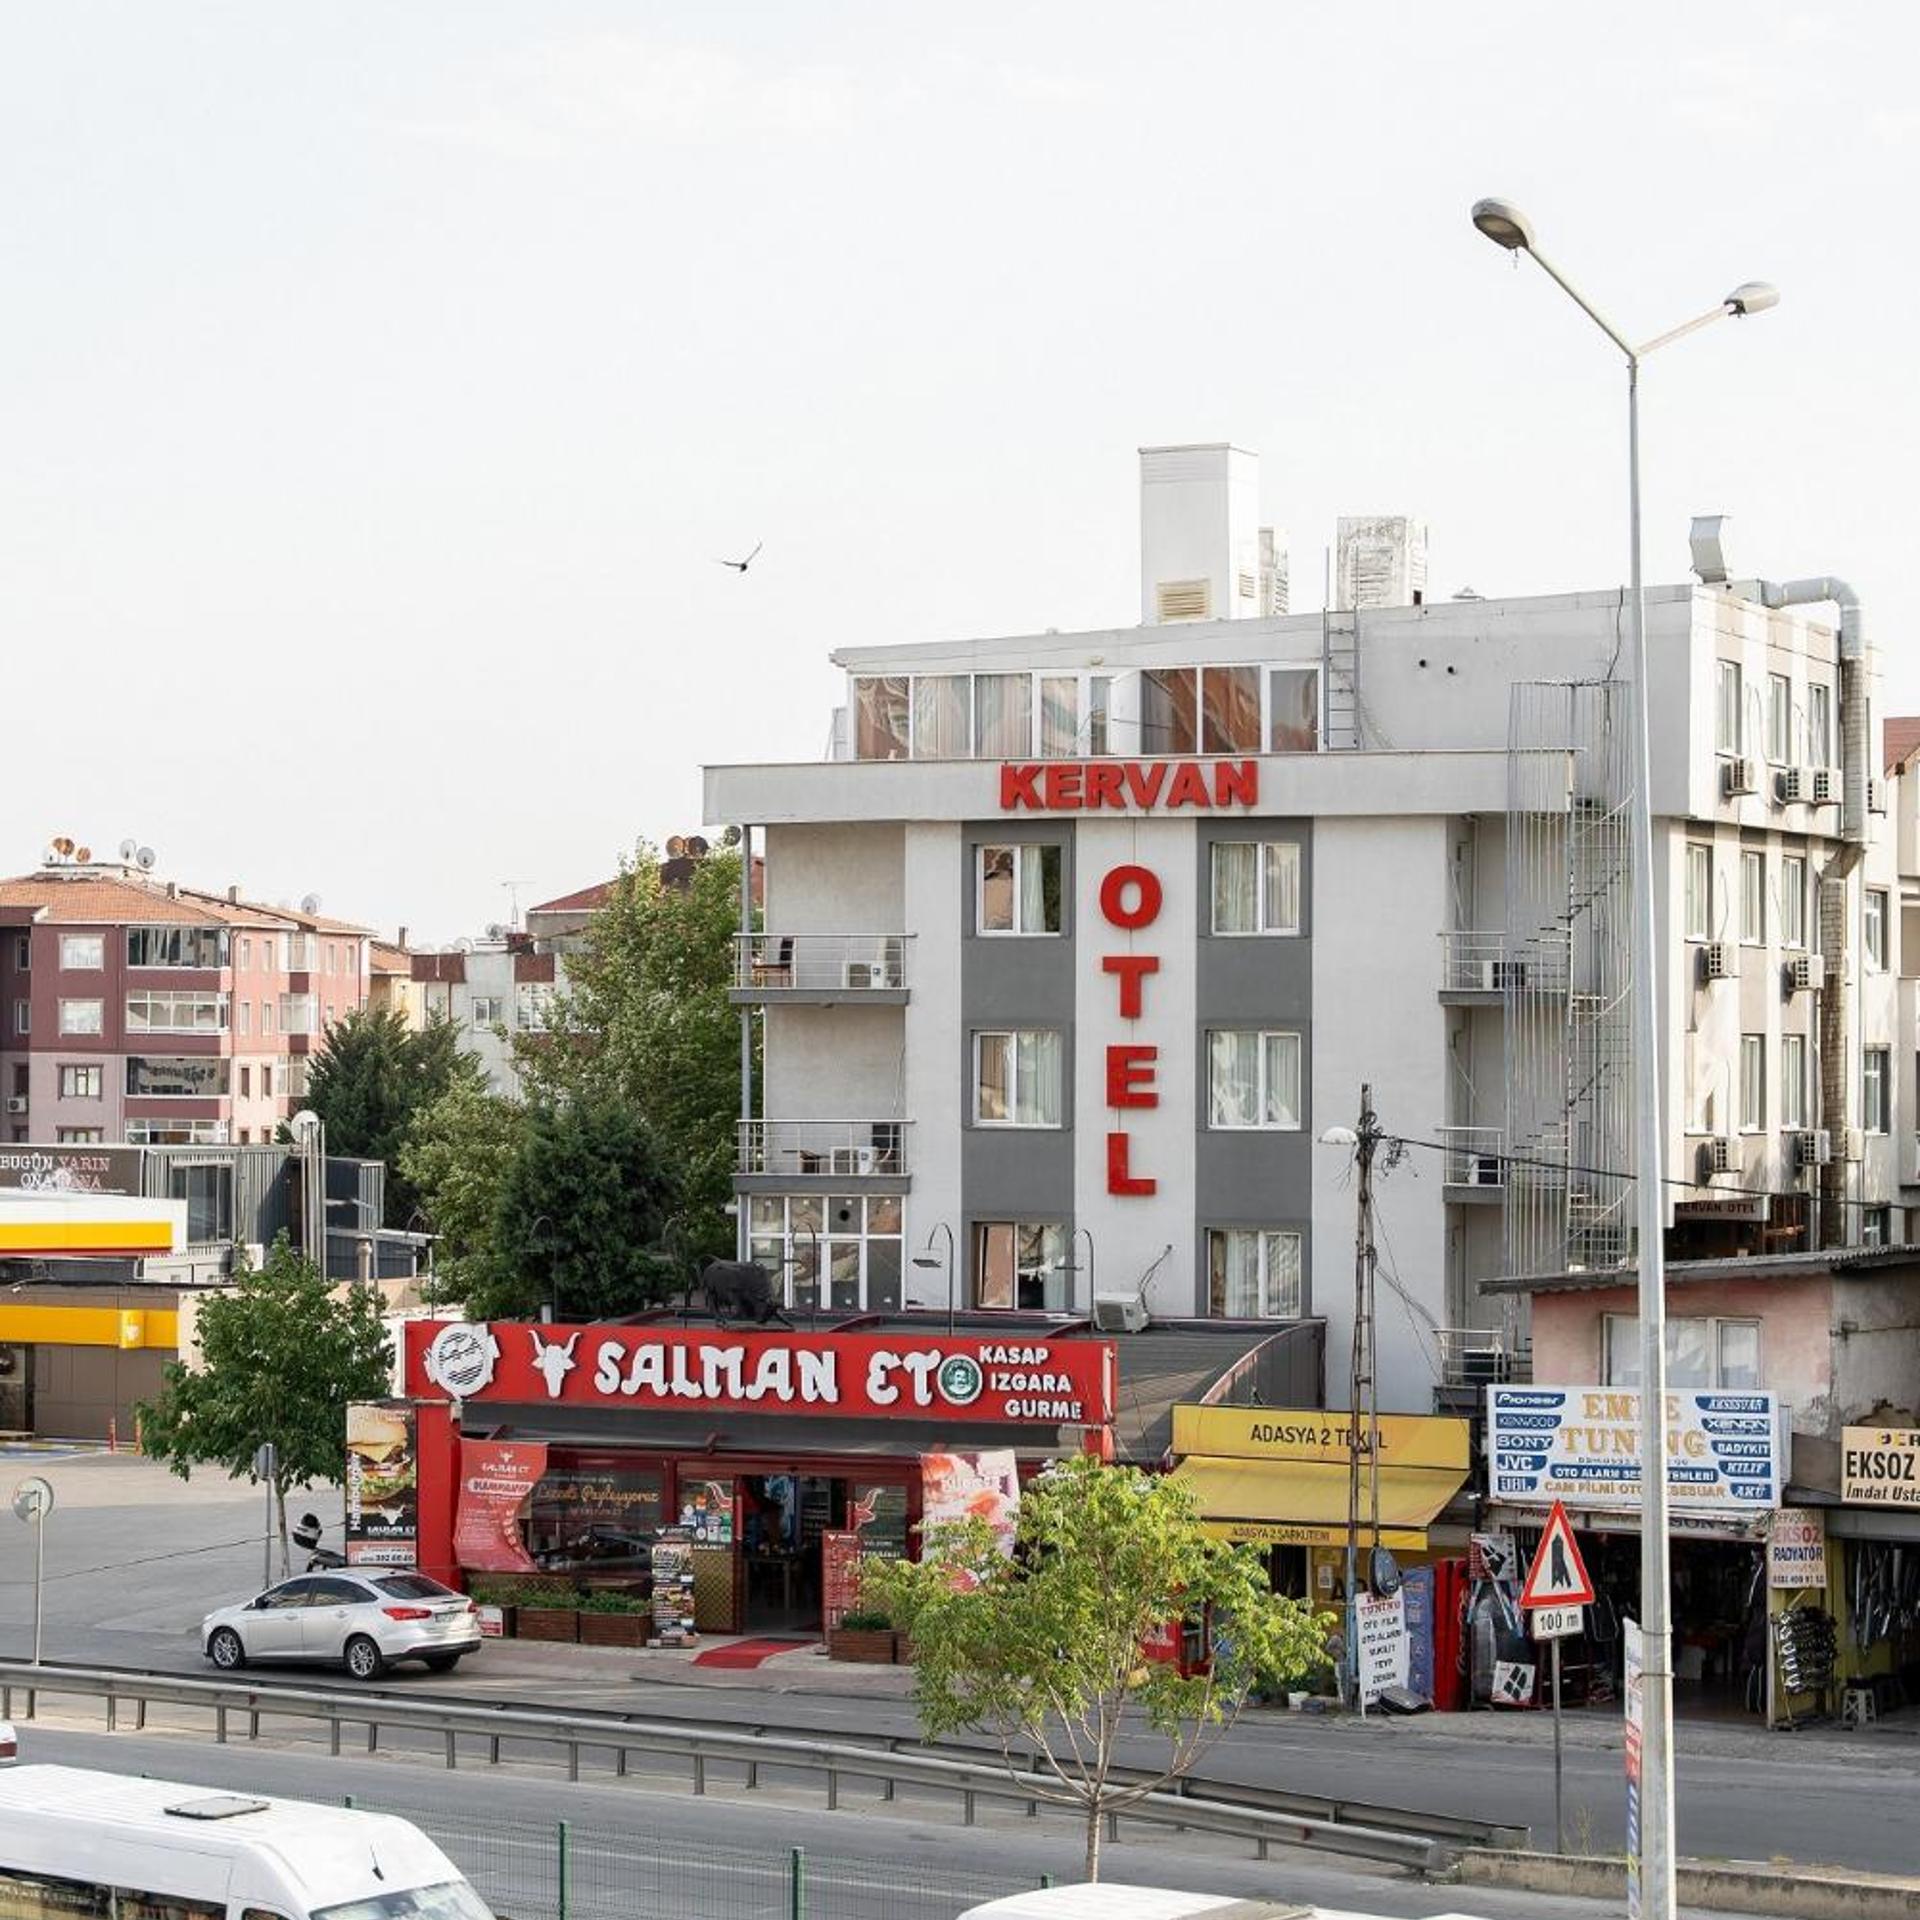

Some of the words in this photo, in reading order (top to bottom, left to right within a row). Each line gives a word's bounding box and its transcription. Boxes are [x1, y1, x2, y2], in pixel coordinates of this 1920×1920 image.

[1000, 761, 1258, 810] KERVAN
[1100, 865, 1164, 1197] OTEL
[979, 1346, 1049, 1366] KASAP
[594, 1341, 839, 1403] SALMAN
[990, 1374, 1072, 1394] IZGARA
[1498, 1393, 1559, 1405] Pioneer
[1582, 1393, 1681, 1421] EME
[1499, 1416, 1556, 1428] KENWOOD
[1250, 1424, 1316, 1445] ADASYA
[1320, 1428, 1331, 1445] 2
[1335, 1429, 1388, 1448] TEKL
[1497, 1436, 1553, 1449] SONY
[1498, 1455, 1533, 1470] JVC
[1846, 1451, 1915, 1481] EKSOZ
[1555, 1468, 1578, 1478] OTO
[1581, 1469, 1620, 1480] ALARM
[1774, 1526, 1821, 1544] EKSOZ
[1540, 1612, 1562, 1631] 100
[1567, 1613, 1580, 1627] m
